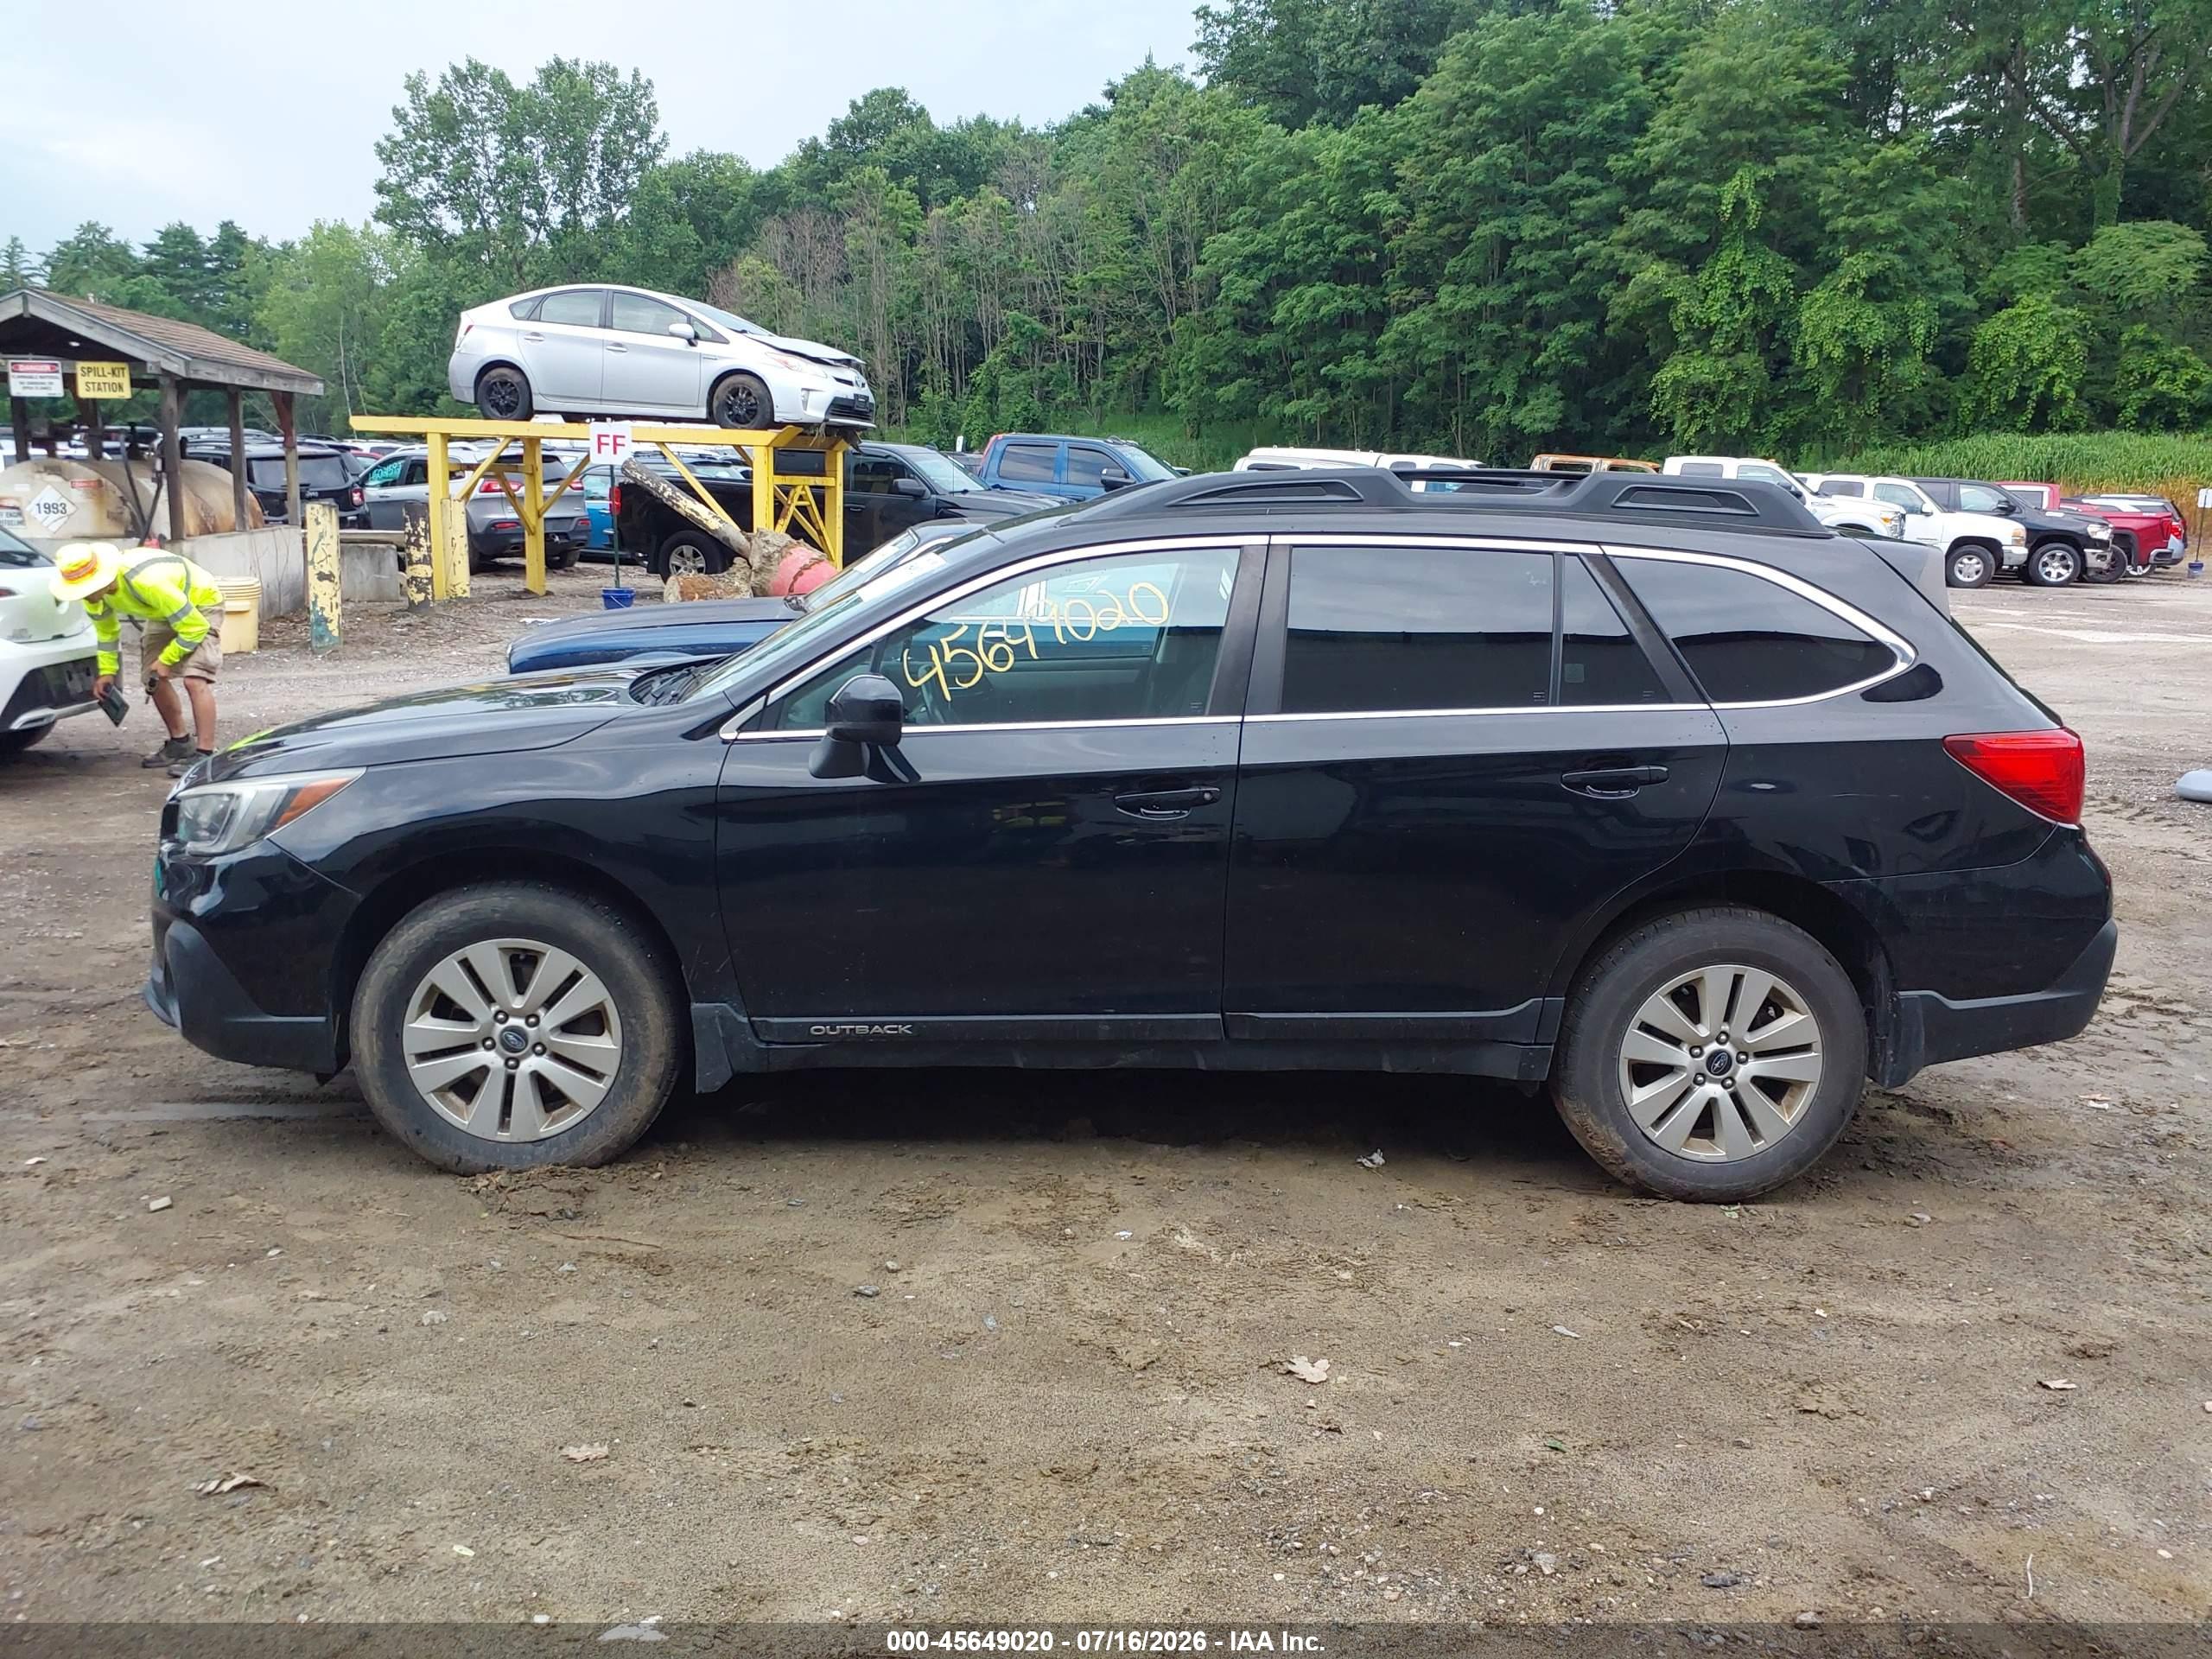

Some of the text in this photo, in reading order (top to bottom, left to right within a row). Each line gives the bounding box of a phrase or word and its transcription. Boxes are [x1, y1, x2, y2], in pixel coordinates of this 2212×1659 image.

[80, 366, 126, 378] SPILL-KIT
[85, 381, 124, 393] STATION
[597, 434, 626, 455] FF
[35, 502, 67, 515] 1993
[903, 582, 1169, 702] 45649020
[810, 1024, 913, 1035] OUTBACK
